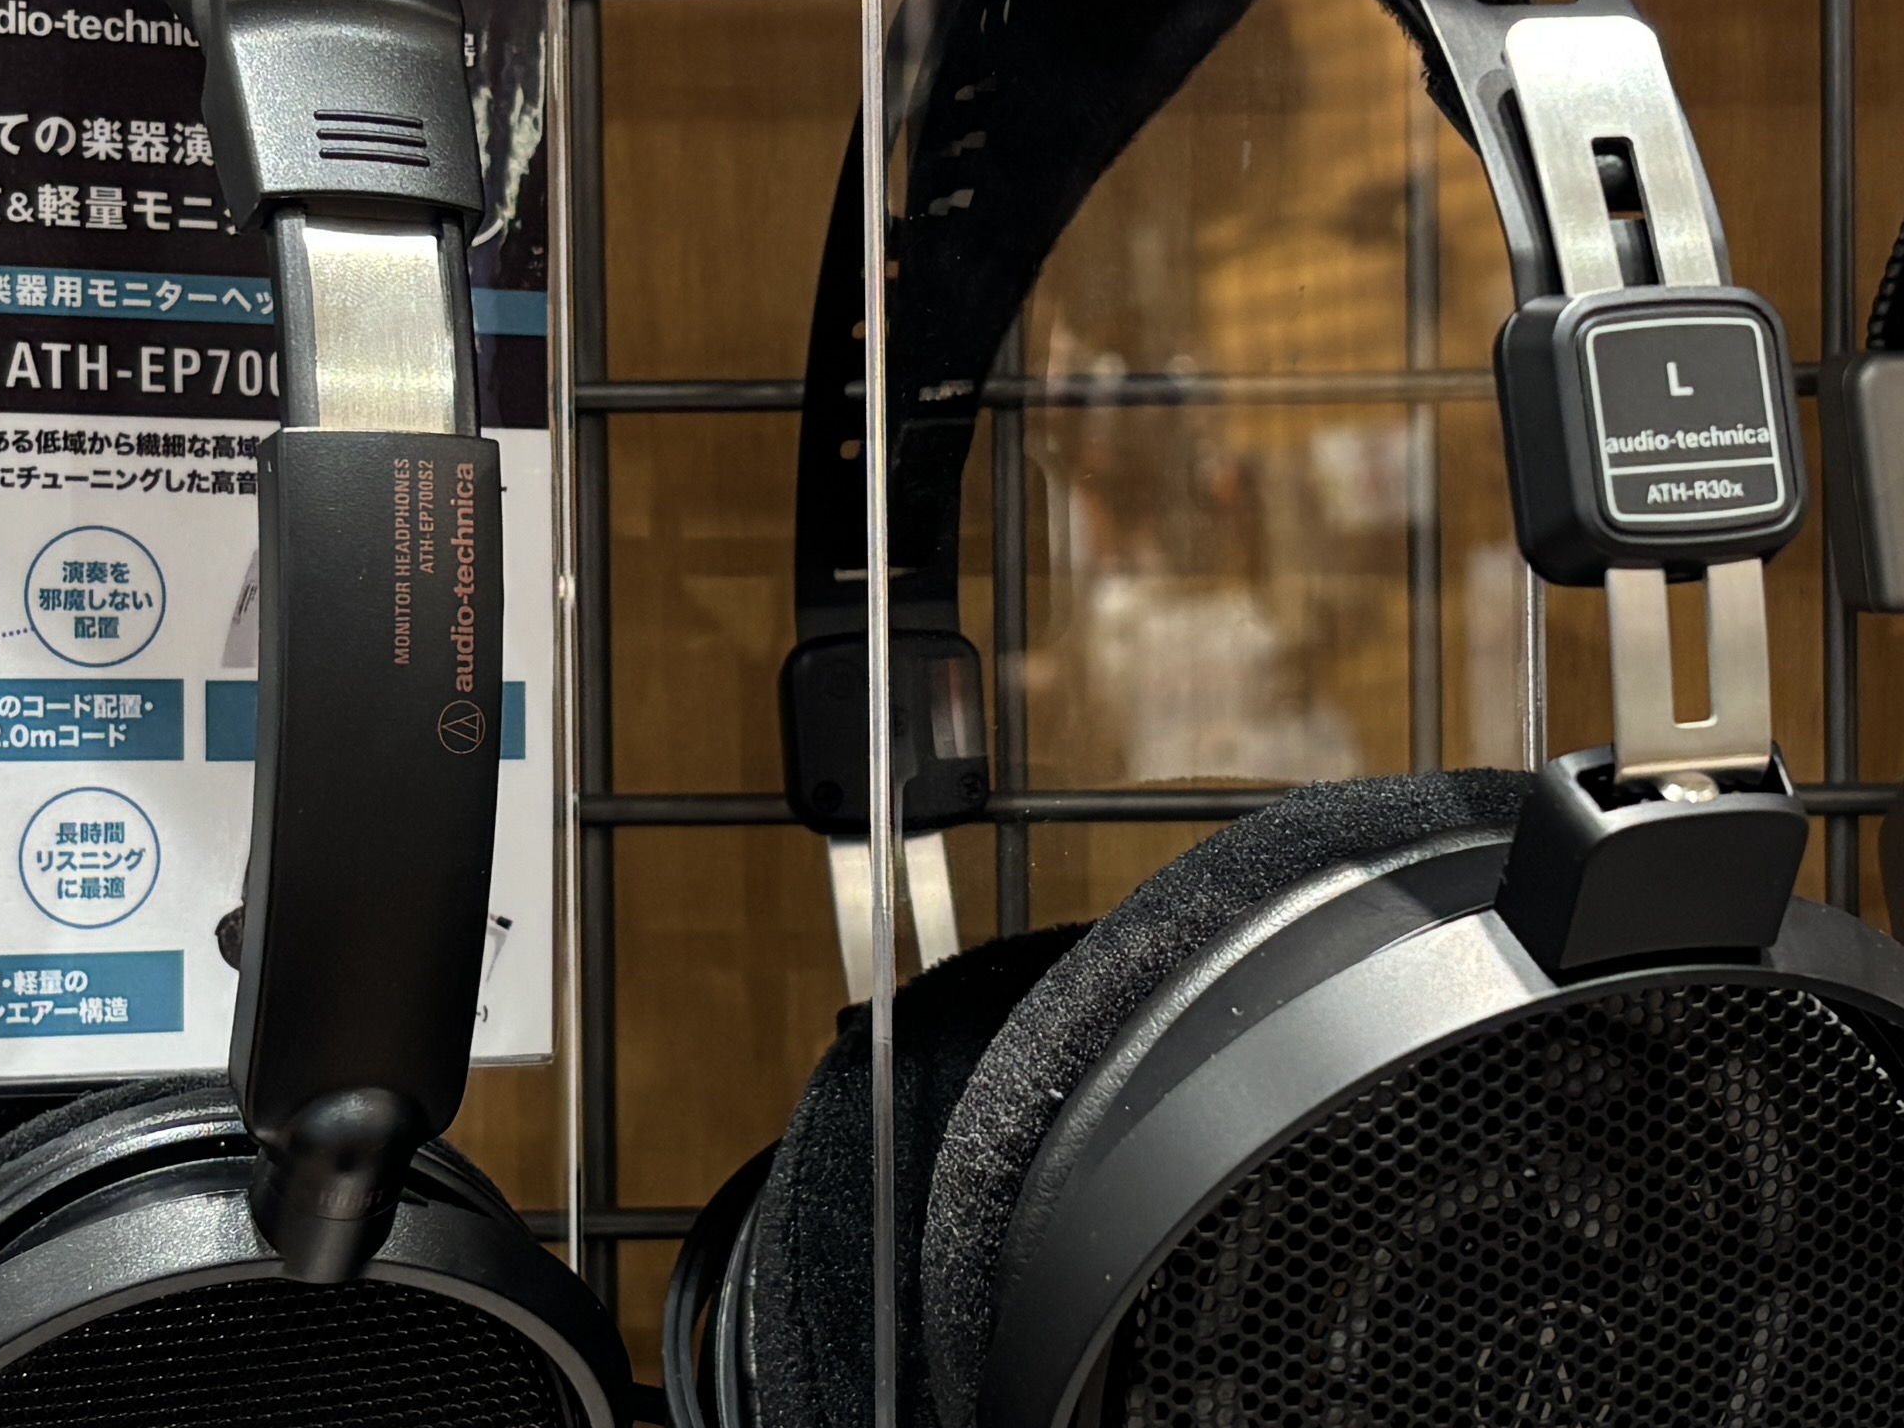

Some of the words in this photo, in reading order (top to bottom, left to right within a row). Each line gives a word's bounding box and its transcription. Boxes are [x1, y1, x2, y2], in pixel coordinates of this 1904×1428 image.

[1666, 361, 1694, 396] L
[1604, 423, 1771, 455] audio-technica
[1647, 479, 1744, 504] ATH-R30x
[394, 458, 411, 577] HEADPHONES
[418, 459, 435, 574] ATH-EP700S2
[62, 561, 131, 584] 演奏を
[450, 462, 475, 693] audio-technica
[39, 588, 154, 612] 邪魔しない
[73, 616, 120, 640] 配置
[394, 582, 411, 665] MONITOR
[55, 822, 125, 846] 長時間
[36, 848, 146, 872] リスニング
[57, 876, 125, 900] に最適
